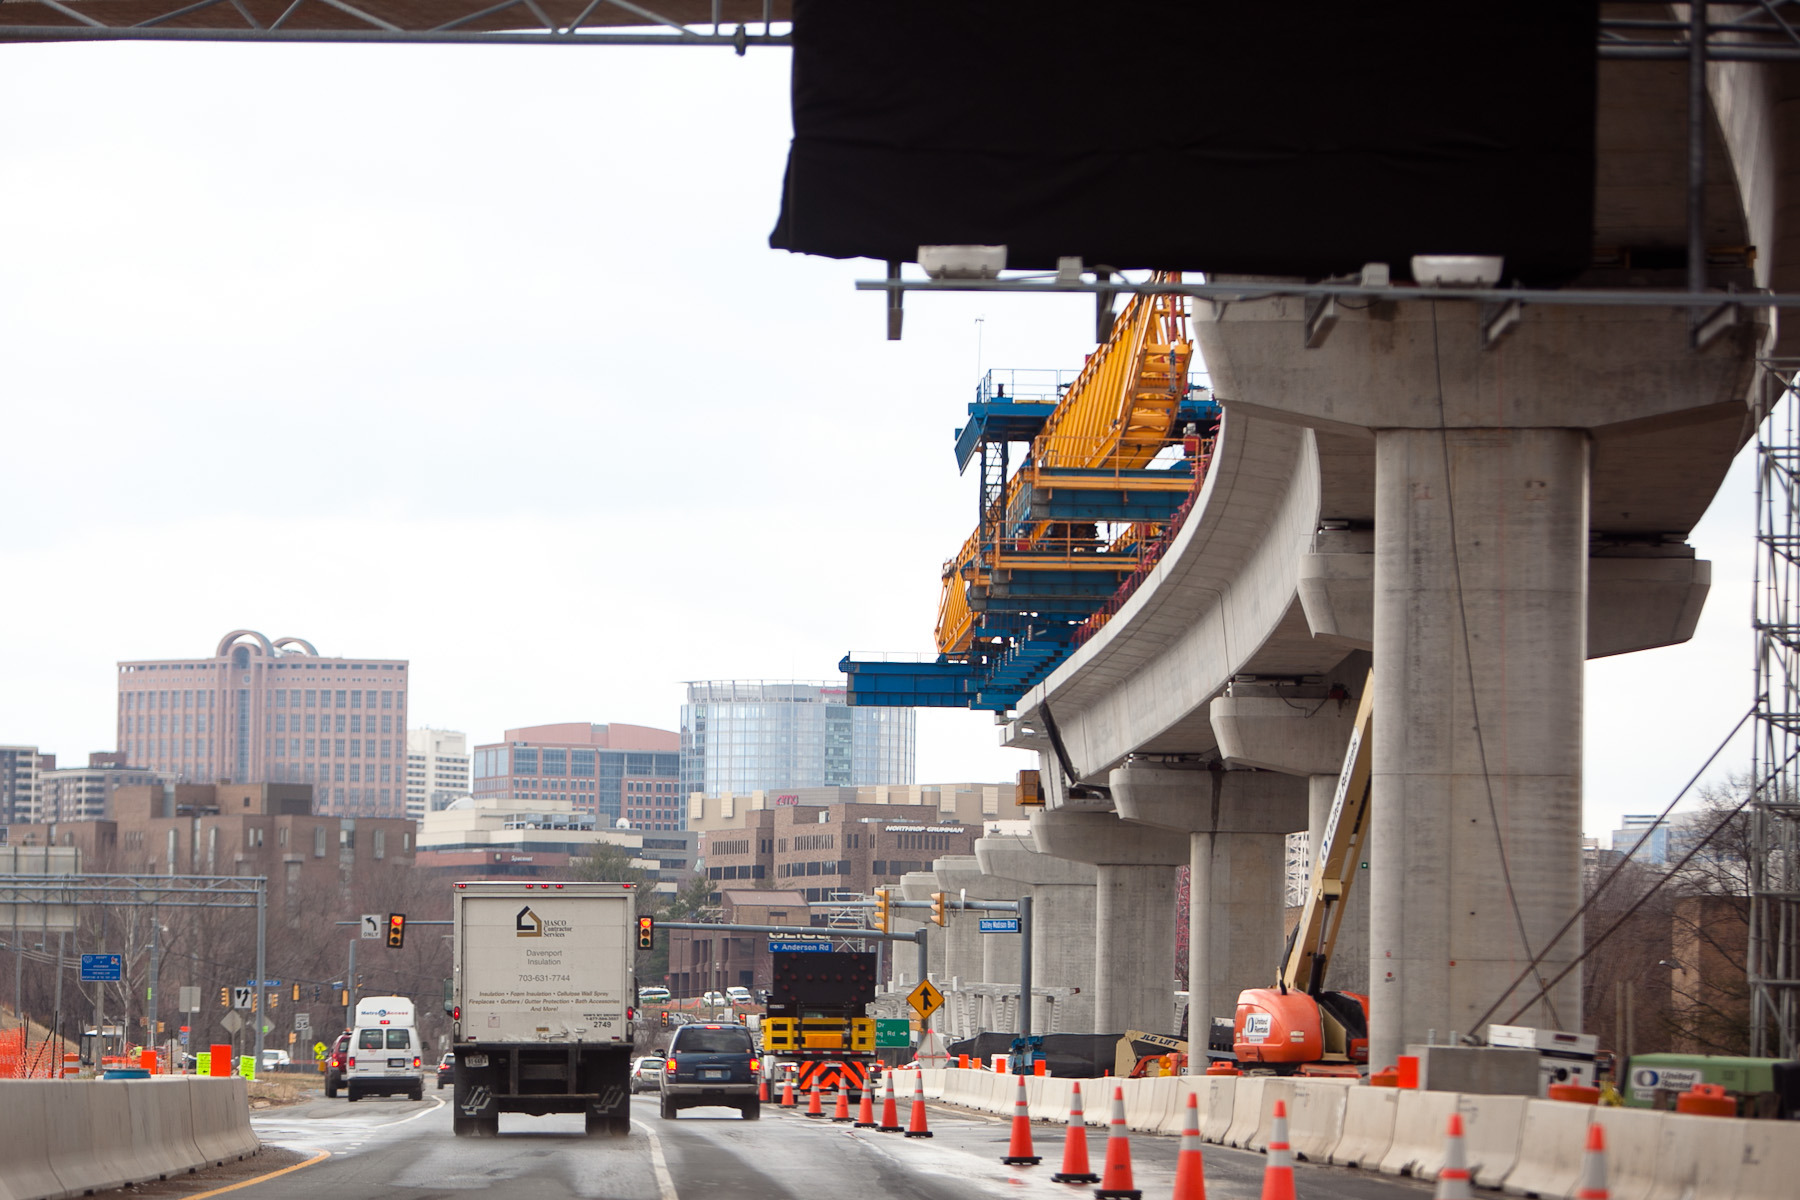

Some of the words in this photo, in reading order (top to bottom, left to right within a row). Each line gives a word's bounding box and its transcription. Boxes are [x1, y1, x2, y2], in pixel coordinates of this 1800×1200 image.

[1327, 790, 1343, 841] United
[1341, 738, 1357, 789] Rentals
[526, 949, 562, 958] Davenport
[296, 1021, 309, 1029] 35
[1140, 1034, 1158, 1042] JLG
[1158, 1037, 1179, 1047] LIFT
[1661, 1071, 1695, 1081] United
[1661, 1080, 1693, 1089] Rental
